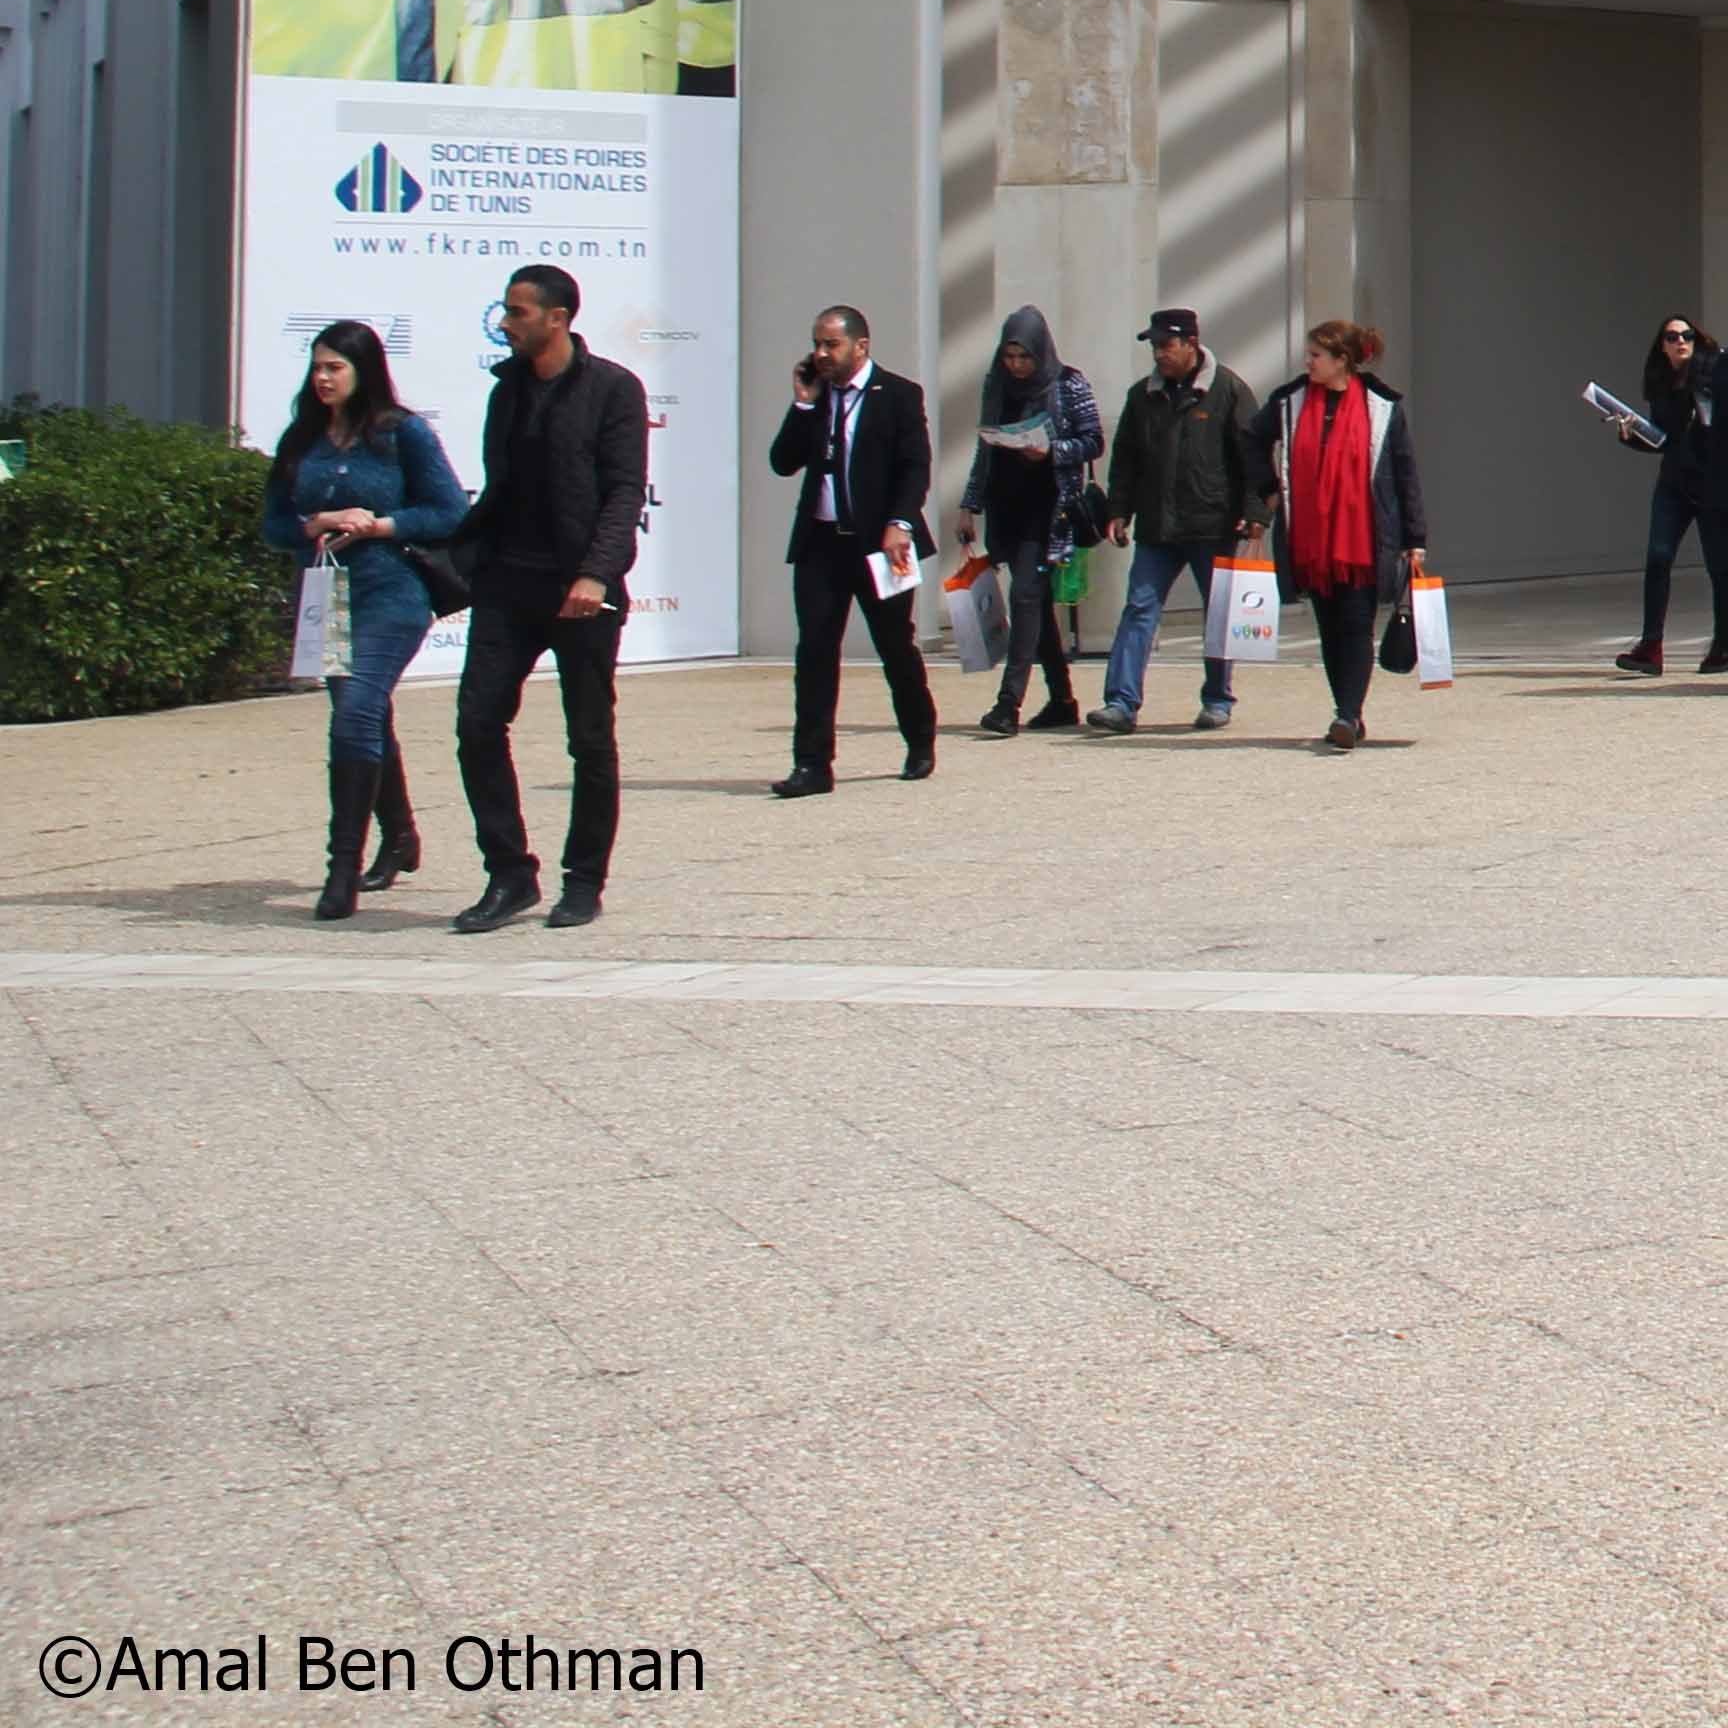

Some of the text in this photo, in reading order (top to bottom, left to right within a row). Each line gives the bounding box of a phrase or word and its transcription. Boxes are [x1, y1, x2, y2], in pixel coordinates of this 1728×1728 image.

[431, 140, 647, 168] SOCIÉTÉ DES FOIRES
[431, 169, 647, 192] INTERNATIONALES
[431, 194, 531, 214] DE TUNIS
[334, 233, 647, 258] www.fkram.com.tn
